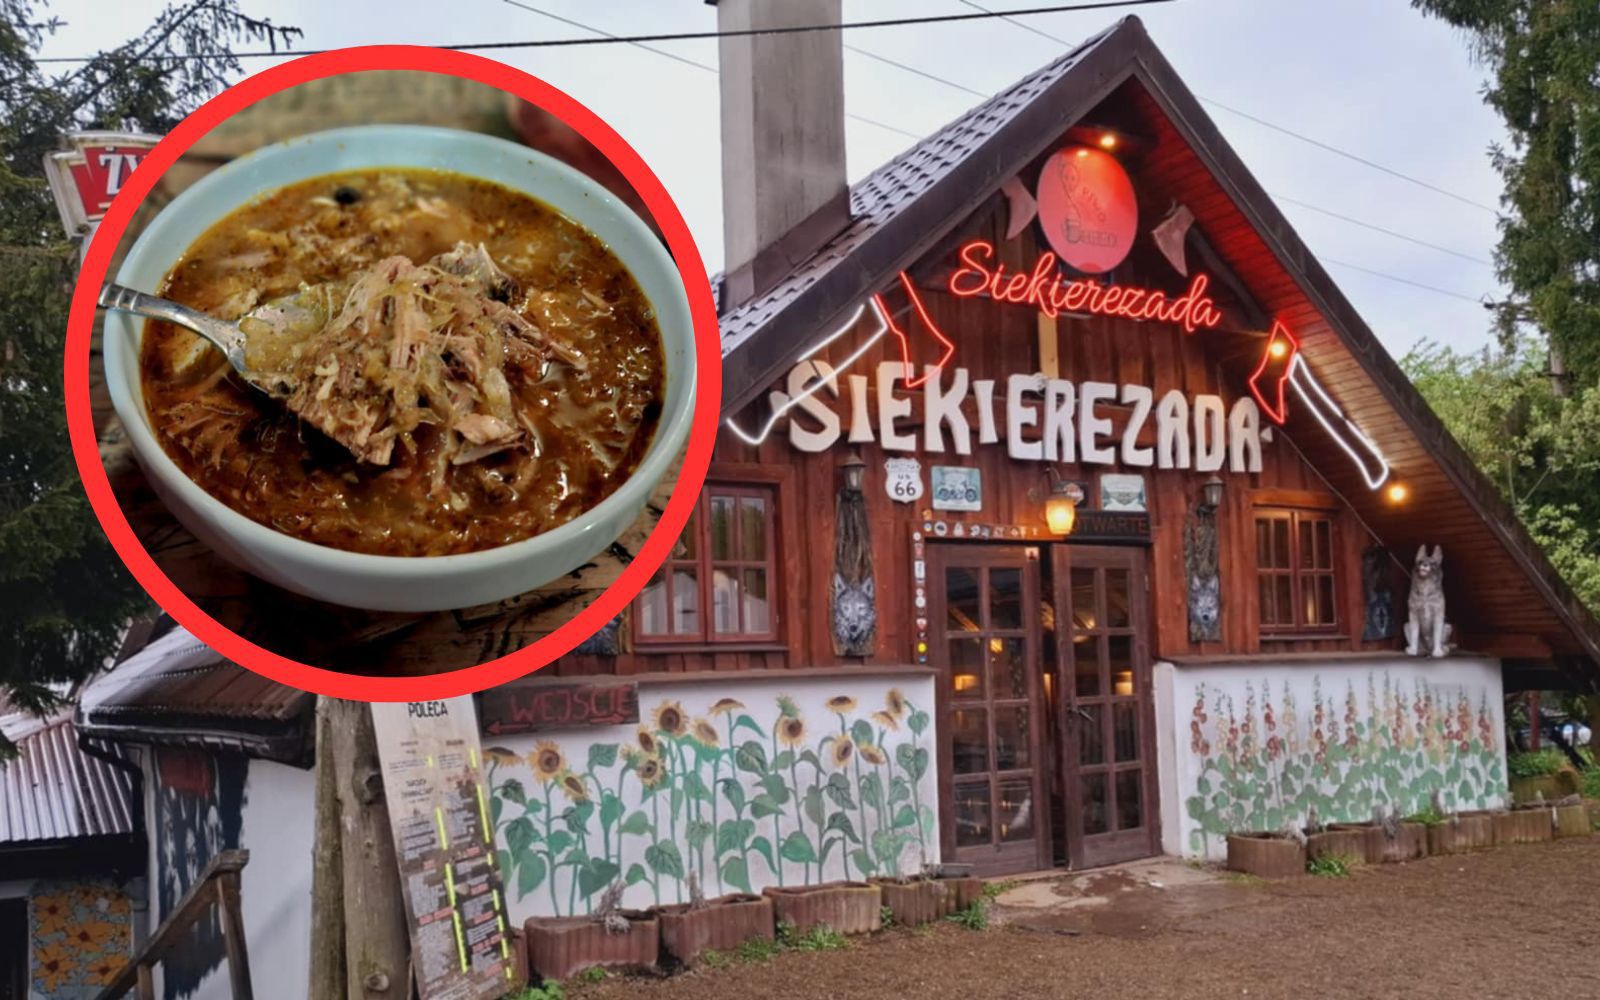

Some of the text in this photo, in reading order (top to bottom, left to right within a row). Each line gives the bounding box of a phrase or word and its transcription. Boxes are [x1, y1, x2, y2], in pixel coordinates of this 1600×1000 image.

[949, 241, 1221, 332] Siekierezada
[787, 359, 1263, 473] SIEKIEREZADA
[894, 480, 917, 497] 66
[407, 701, 448, 718] POLECA
